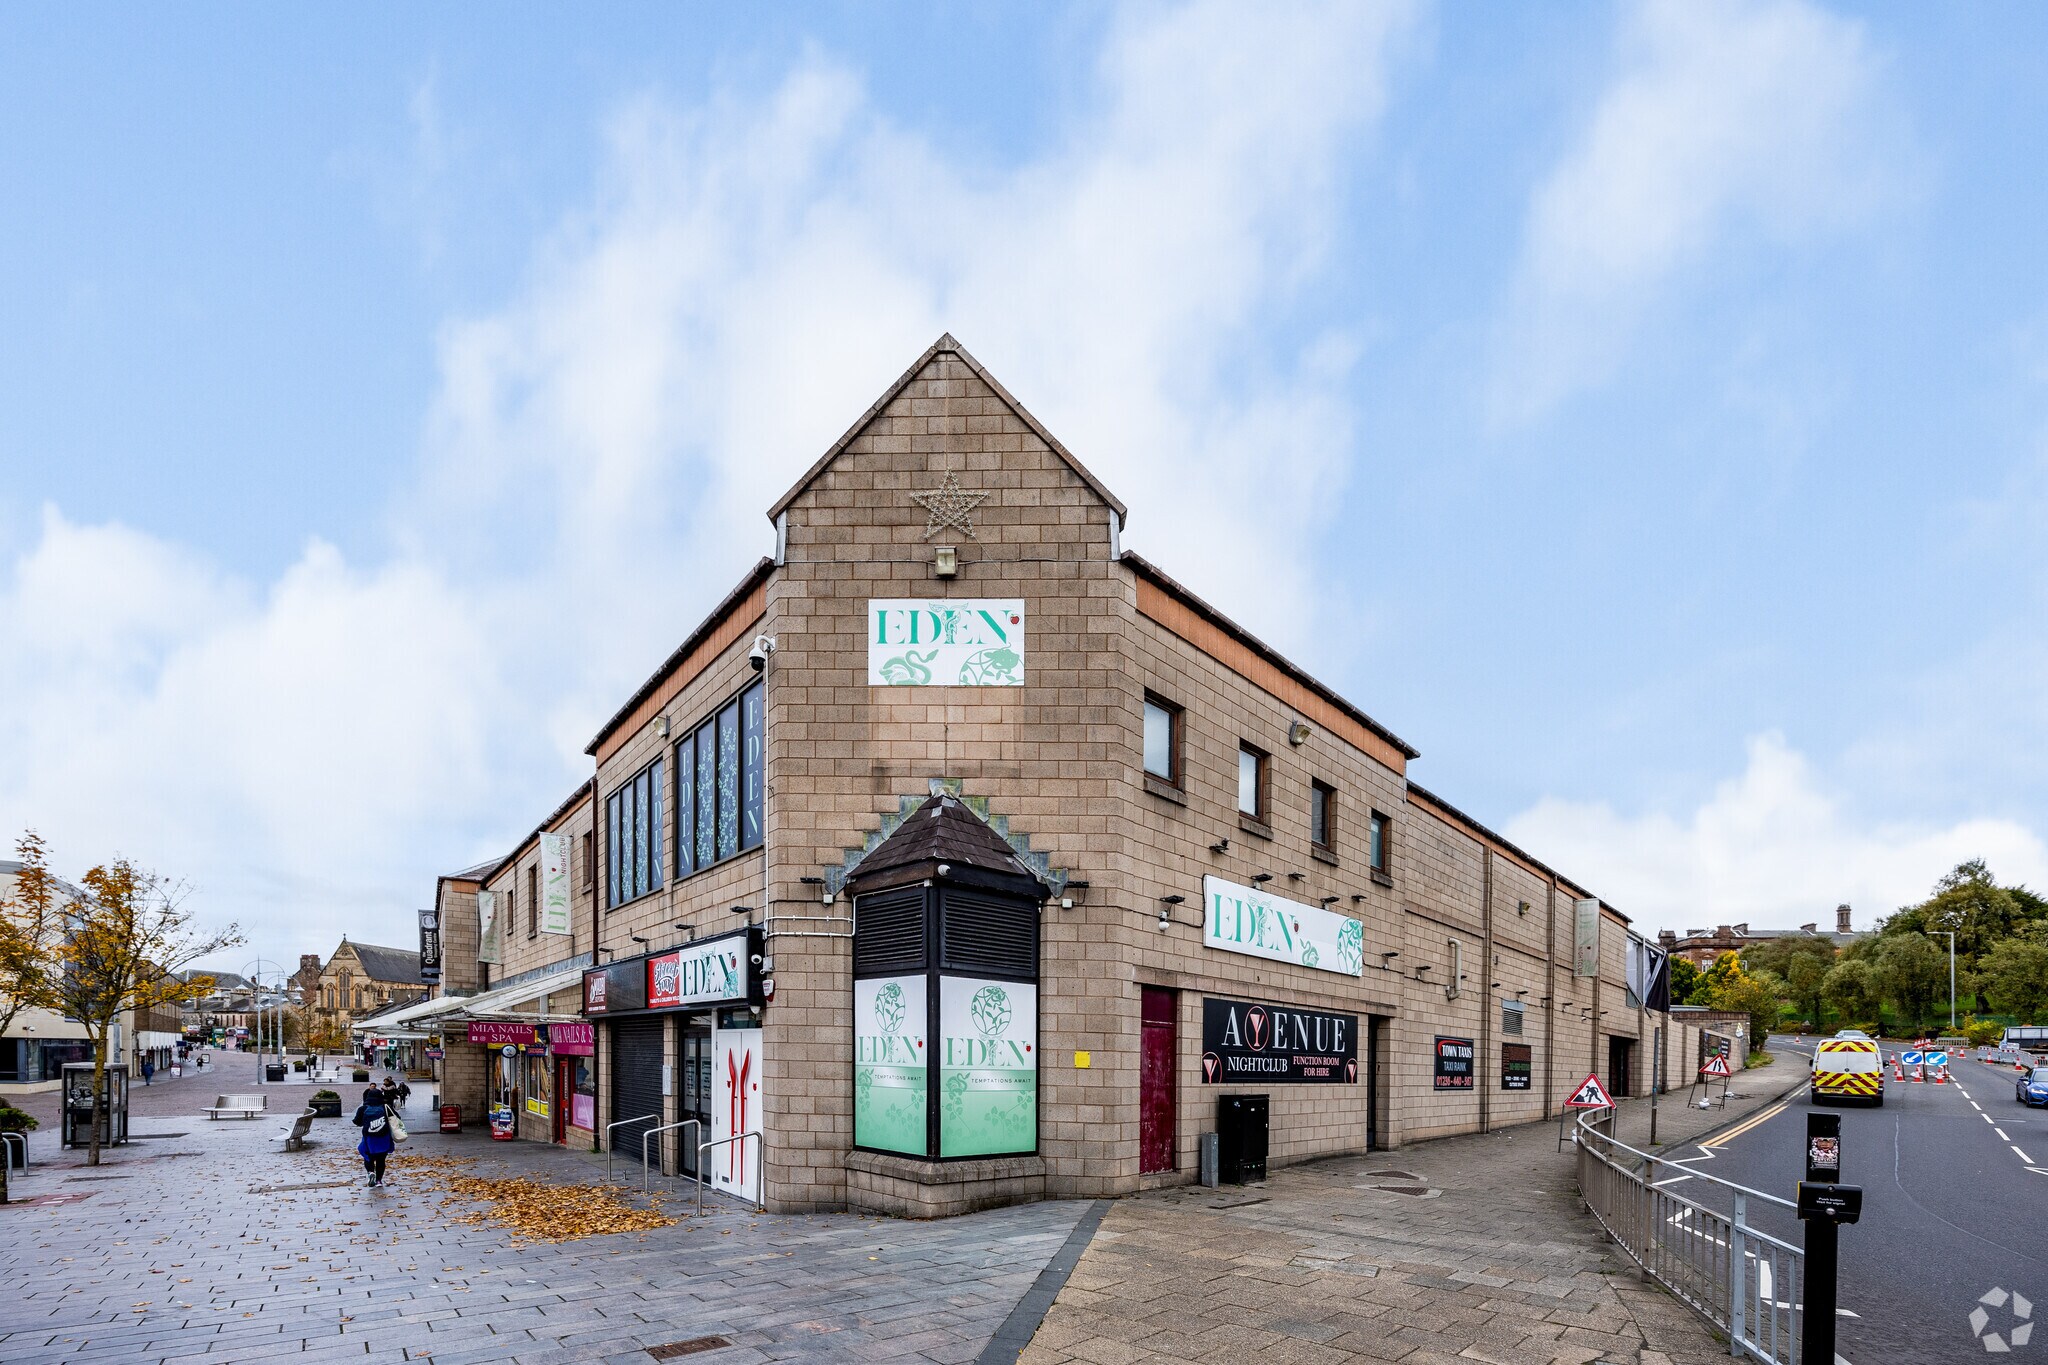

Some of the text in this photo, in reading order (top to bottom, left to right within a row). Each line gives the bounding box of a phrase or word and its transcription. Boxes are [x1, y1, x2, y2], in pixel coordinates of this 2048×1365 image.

[876, 609, 1013, 645] EDEN
[747, 697, 760, 839] EDEN
[681, 750, 691, 870] EDEN
[654, 771, 662, 882] EDEN
[548, 868, 566, 931] EDEN
[1213, 893, 1296, 953] EDEN
[425, 931, 434, 964] Quadrant
[682, 951, 734, 997] EDEN
[472, 1024, 532, 1034] MIA NAILS
[491, 1034, 513, 1042] SPA
[551, 1026, 562, 1043] MIA
[563, 1026, 580, 1043] NAILS
[581, 1026, 587, 1043] &
[858, 1036, 919, 1063] EDEN
[946, 1037, 1027, 1067] EDEN
[1227, 1055, 1340, 1072] NIGHTCLUB FUNCTION ROOM
[1442, 1044, 1472, 1058] TOWN TAXIS
[1304, 1067, 1330, 1077] FOR HIRE
[1443, 1061, 1467, 1071] TAXI RANK
[369, 1116, 386, 1129] NIKE
